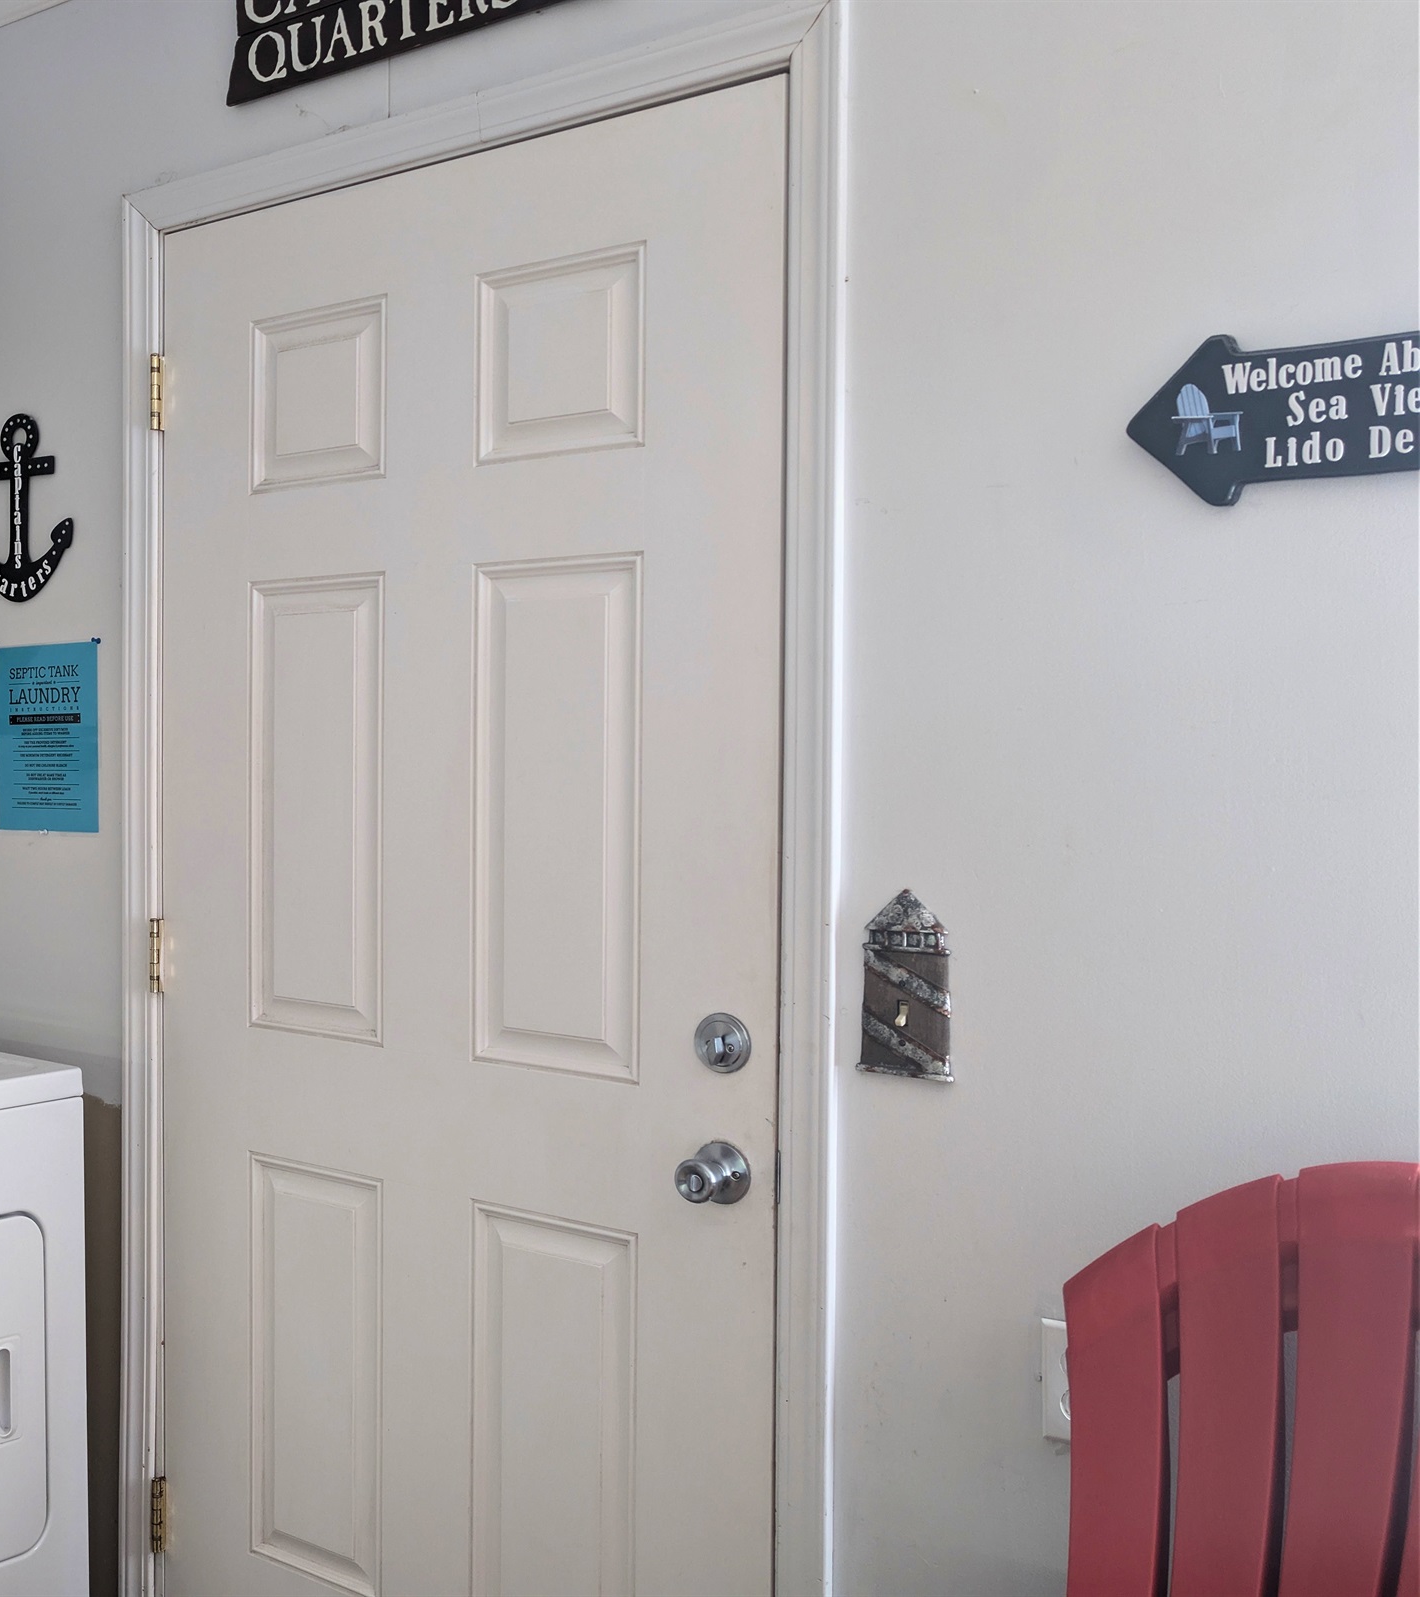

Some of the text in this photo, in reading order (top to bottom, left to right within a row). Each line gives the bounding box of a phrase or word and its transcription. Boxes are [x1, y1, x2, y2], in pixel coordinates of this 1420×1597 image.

[248, 0, 518, 82] QUARTE
[1222, 354, 1363, 395] Welcome
[1286, 390, 1348, 427] Sea
[1264, 425, 1414, 468] Lido De
[13, 445, 22, 569] Captains
[9, 664, 79, 680] SEPTIC TANK
[9, 686, 81, 705] LAUNDRY
